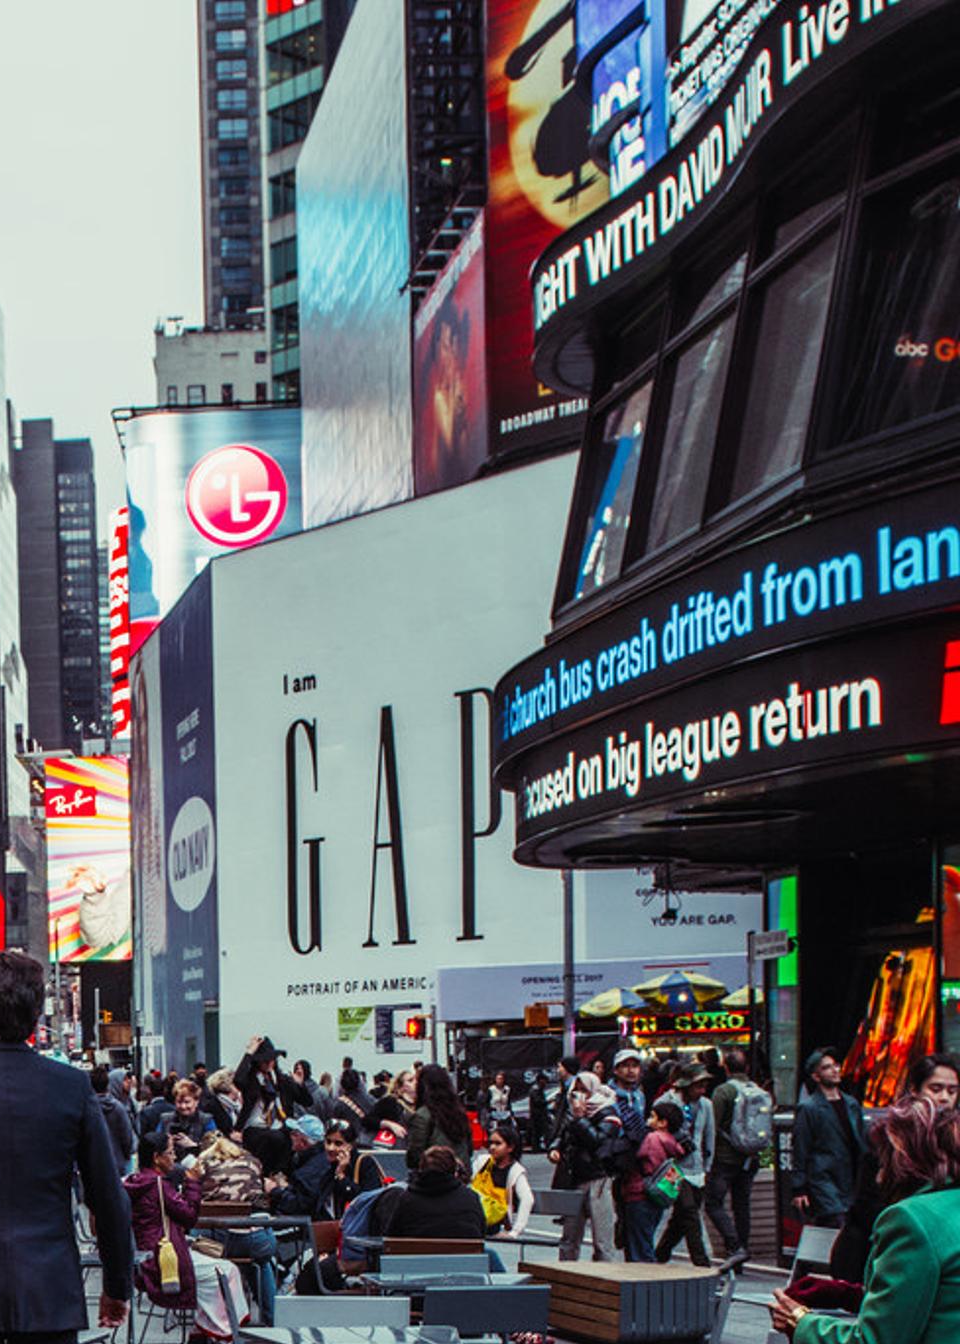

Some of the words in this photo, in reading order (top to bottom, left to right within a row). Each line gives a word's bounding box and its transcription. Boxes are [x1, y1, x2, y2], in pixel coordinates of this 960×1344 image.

[584, 192, 656, 286] WITH
[659, 124, 723, 236] DAVID
[725, 49, 773, 165] MUIR
[782, 0, 850, 86] Live
[894, 339, 929, 357] abc
[500, 405, 556, 435] BROADWAY
[508, 667, 558, 738] church
[559, 659, 594, 712] bus
[596, 619, 657, 691] crash
[662, 571, 753, 664] drifted
[761, 552, 864, 627] from
[283, 674, 289, 695] I
[293, 673, 318, 693] am
[577, 749, 603, 799] on
[606, 732, 640, 797] big
[645, 711, 741, 781] league
[749, 676, 882, 751] return
[285, 687, 503, 956] GAP
[173, 837, 188, 882] OLD
[188, 823, 211, 877] NAVY
[680, 915, 704, 925] ARE
[708, 914, 737, 925] GAP.
[287, 982, 341, 997] PORTRAIT
[344, 980, 358, 994] OF
[362, 980, 379, 992] AN
[522, 976, 561, 985] OPENING
[675, 1015, 745, 1031] GYRO
